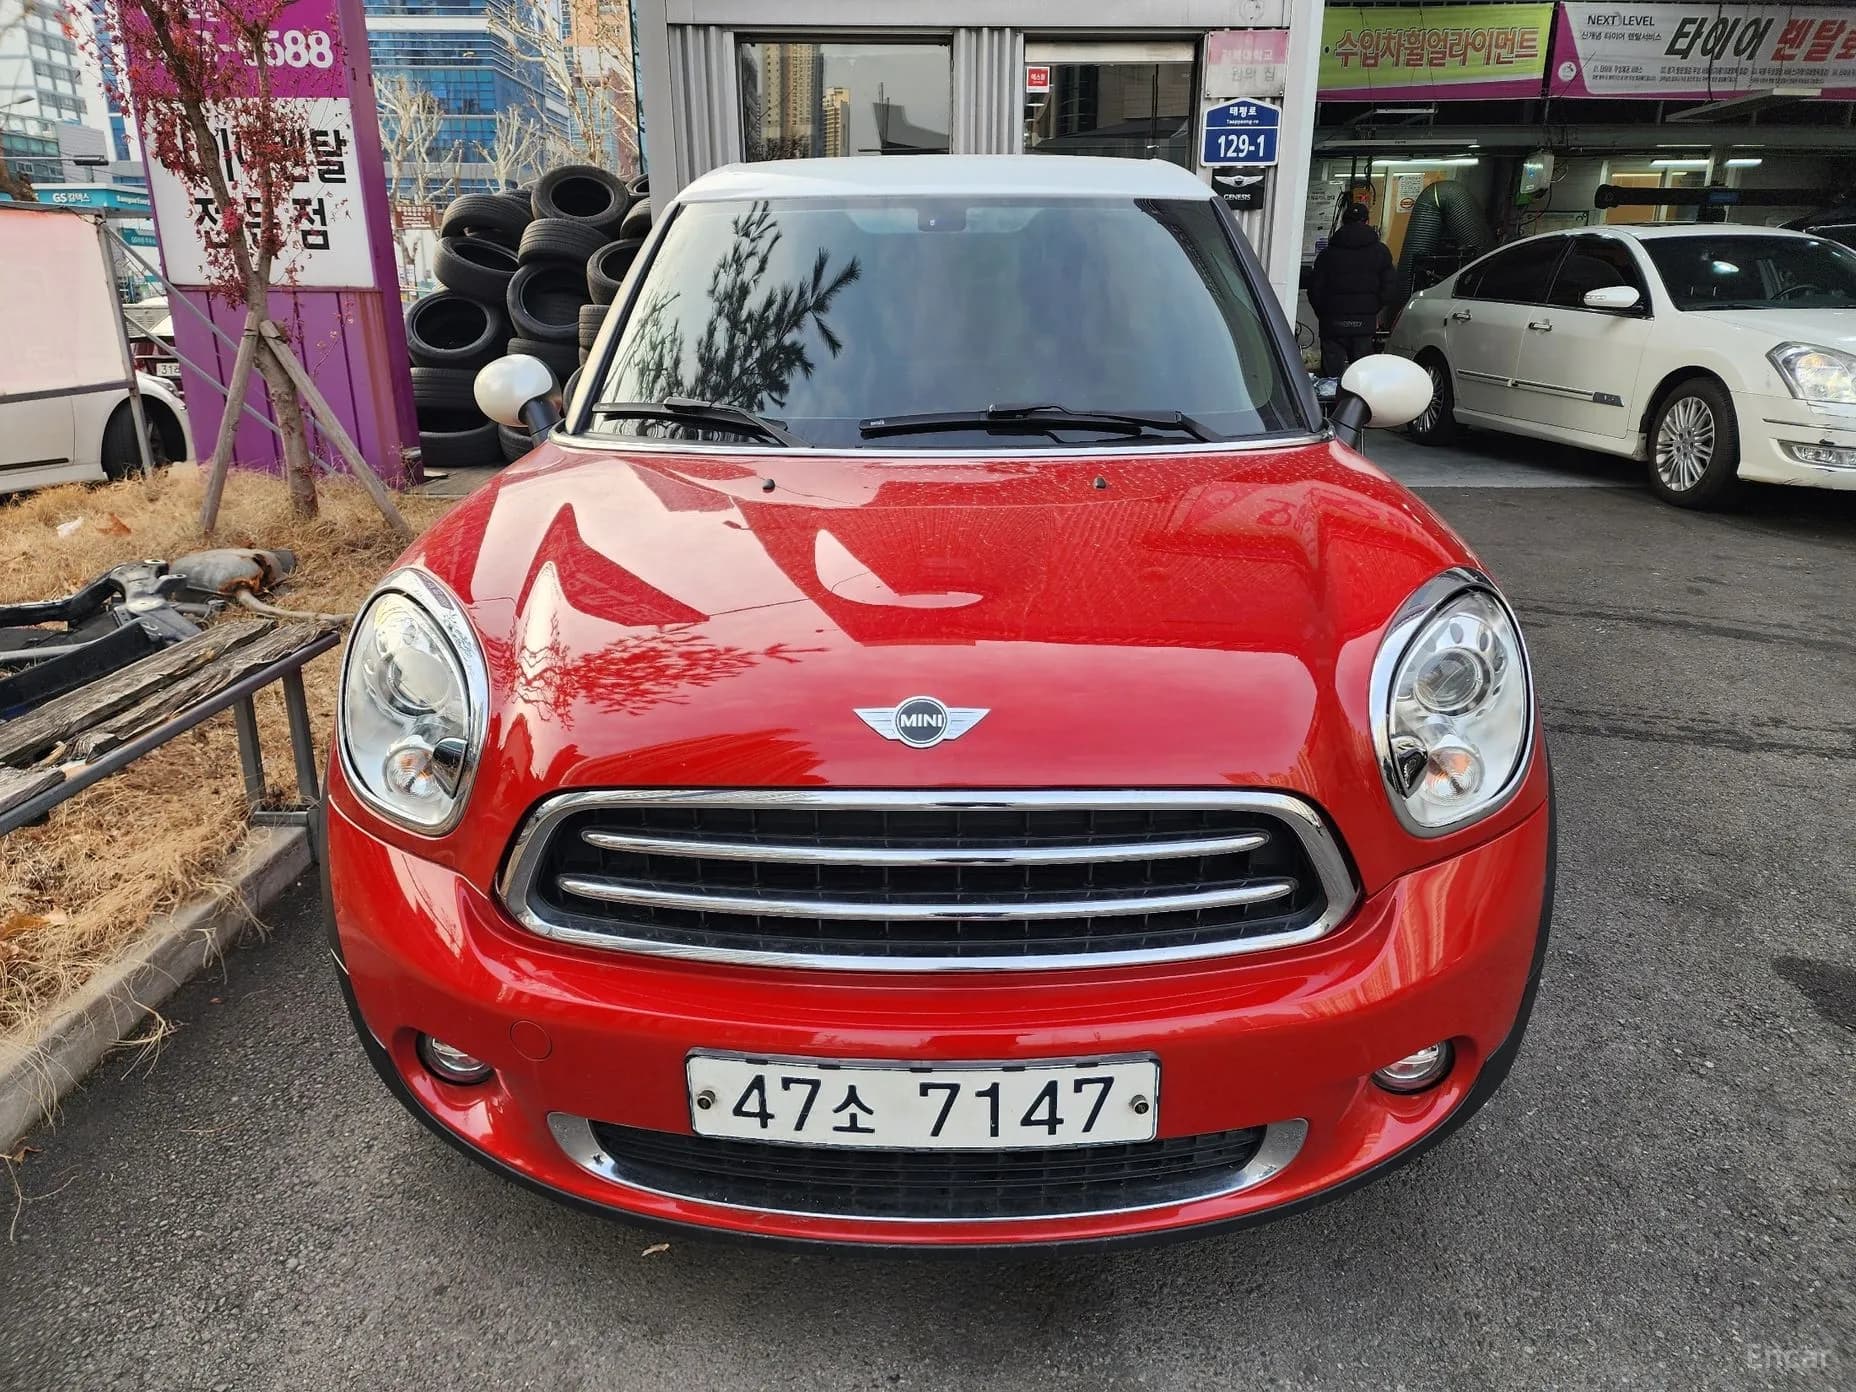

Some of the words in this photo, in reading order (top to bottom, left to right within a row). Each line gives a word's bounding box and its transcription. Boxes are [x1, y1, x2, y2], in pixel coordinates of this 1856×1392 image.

[1587, 15, 1617, 26] NEXT
[1622, 15, 1656, 26] LEVEL
[1604, 32, 1626, 40] 타이어
[1664, 16, 1774, 61] 타이어
[1229, 106, 1257, 118] 태평로
[1217, 134, 1265, 158] 129-1
[900, 713, 943, 728] MINI
[732, 1074, 876, 1134] 47소
[919, 1075, 1115, 1138] 7147
